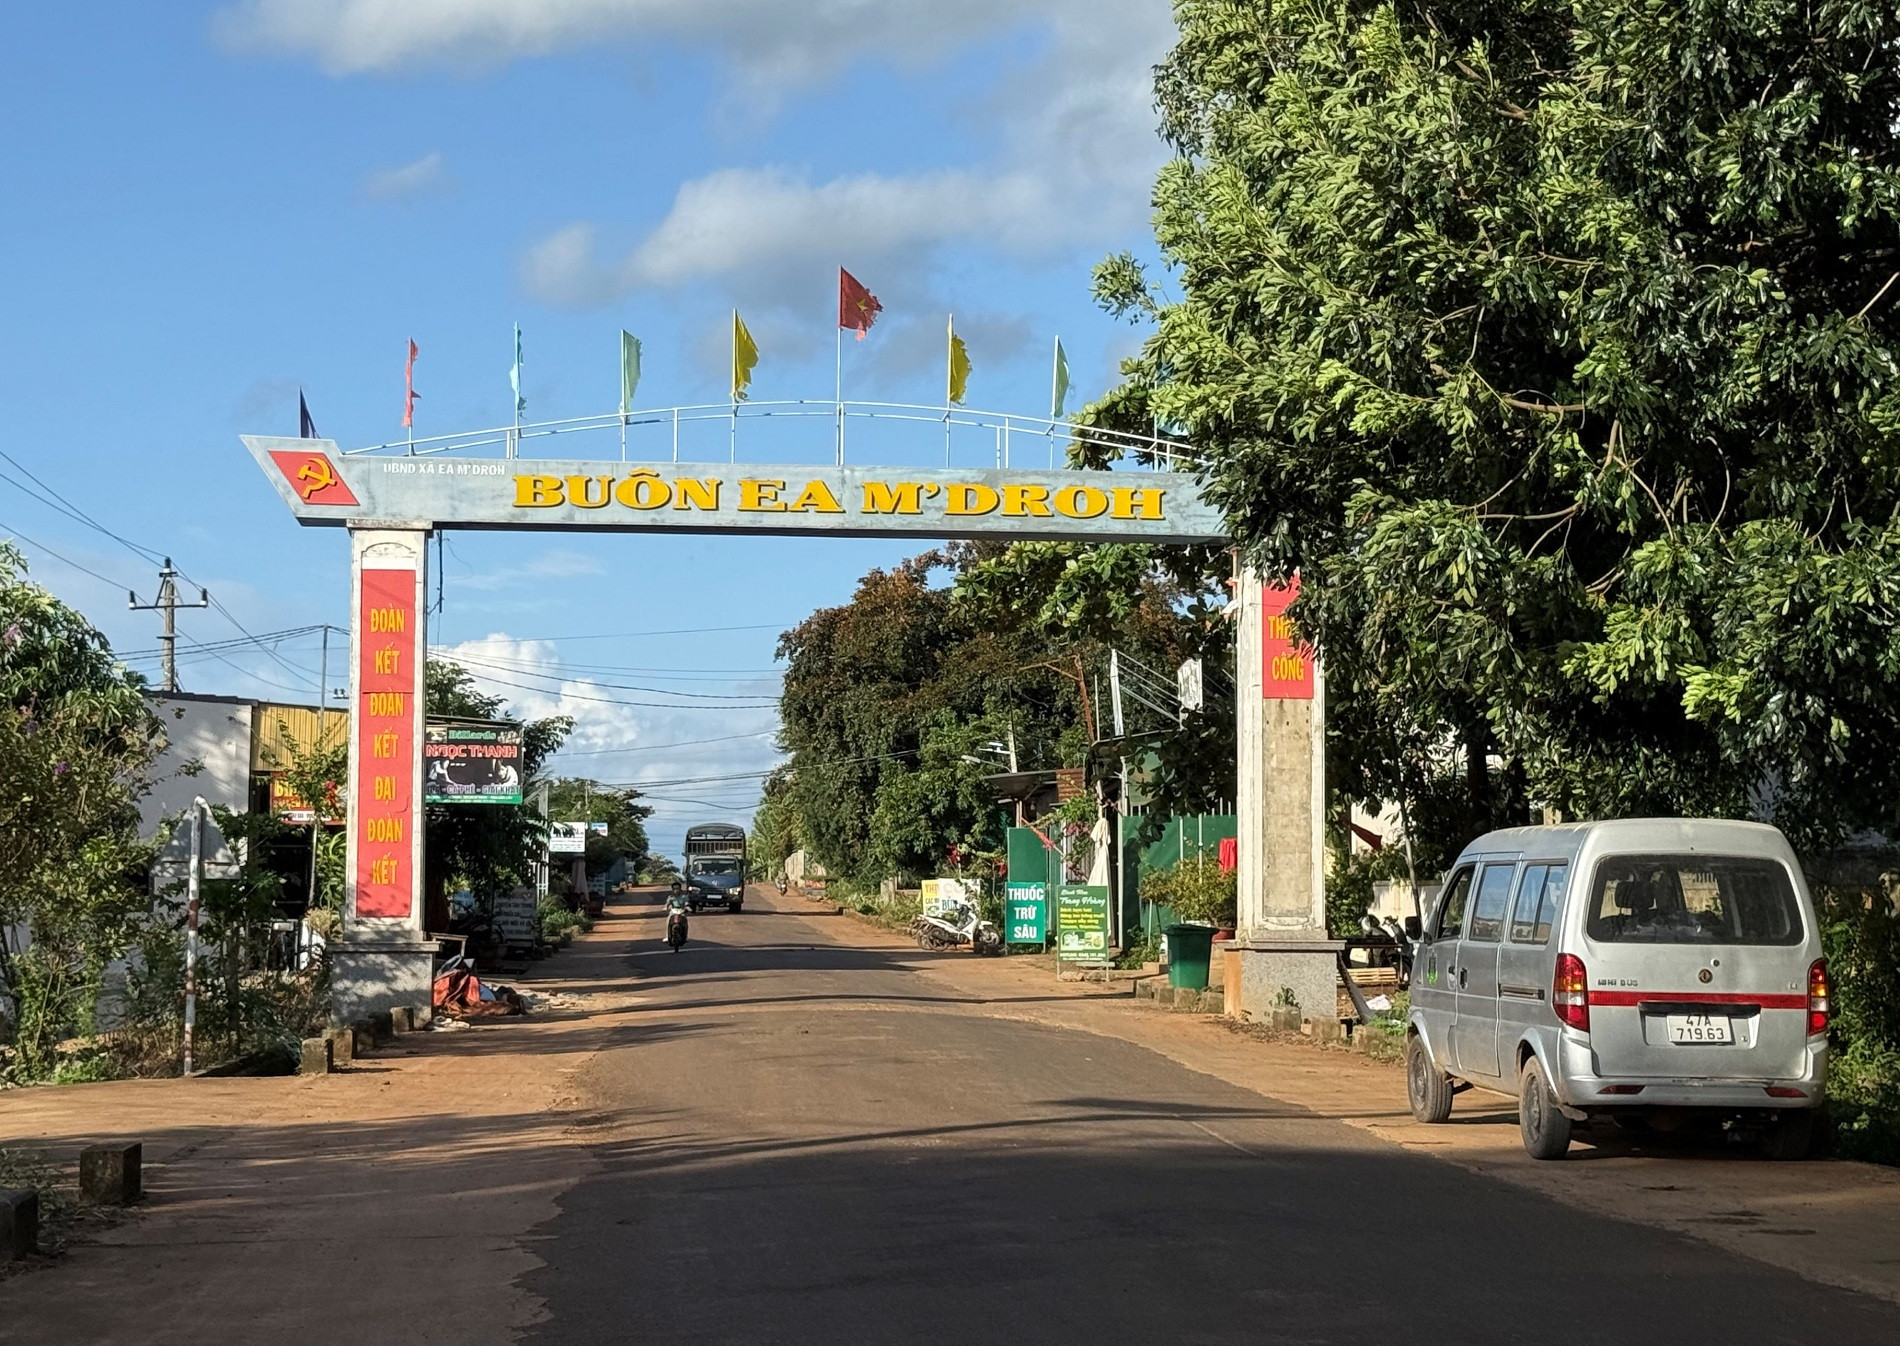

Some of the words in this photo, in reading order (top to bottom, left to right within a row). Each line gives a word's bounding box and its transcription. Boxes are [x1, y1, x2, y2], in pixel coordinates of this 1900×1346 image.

[384, 462, 415, 474] UBND
[419, 461, 434, 474] XÃ
[438, 464, 454, 475] EA
[512, 468, 722, 511] BUÔN
[737, 478, 845, 514] EA
[369, 603, 405, 633] ĐOÀN
[375, 641, 400, 674] KẾT
[1271, 652, 1304, 681] CÔNG
[369, 687, 404, 717] ĐOÀN
[373, 726, 398, 758] KẾT
[375, 776, 396, 805] ĐẠI
[367, 812, 403, 842] ĐOÀN
[372, 852, 398, 885] KẾT
[1008, 884, 1044, 901] THUỐC
[1014, 923, 1037, 939] SÂU
[1676, 1028, 1724, 1040] 719.63
[1686, 1015, 1712, 1026] 47A
